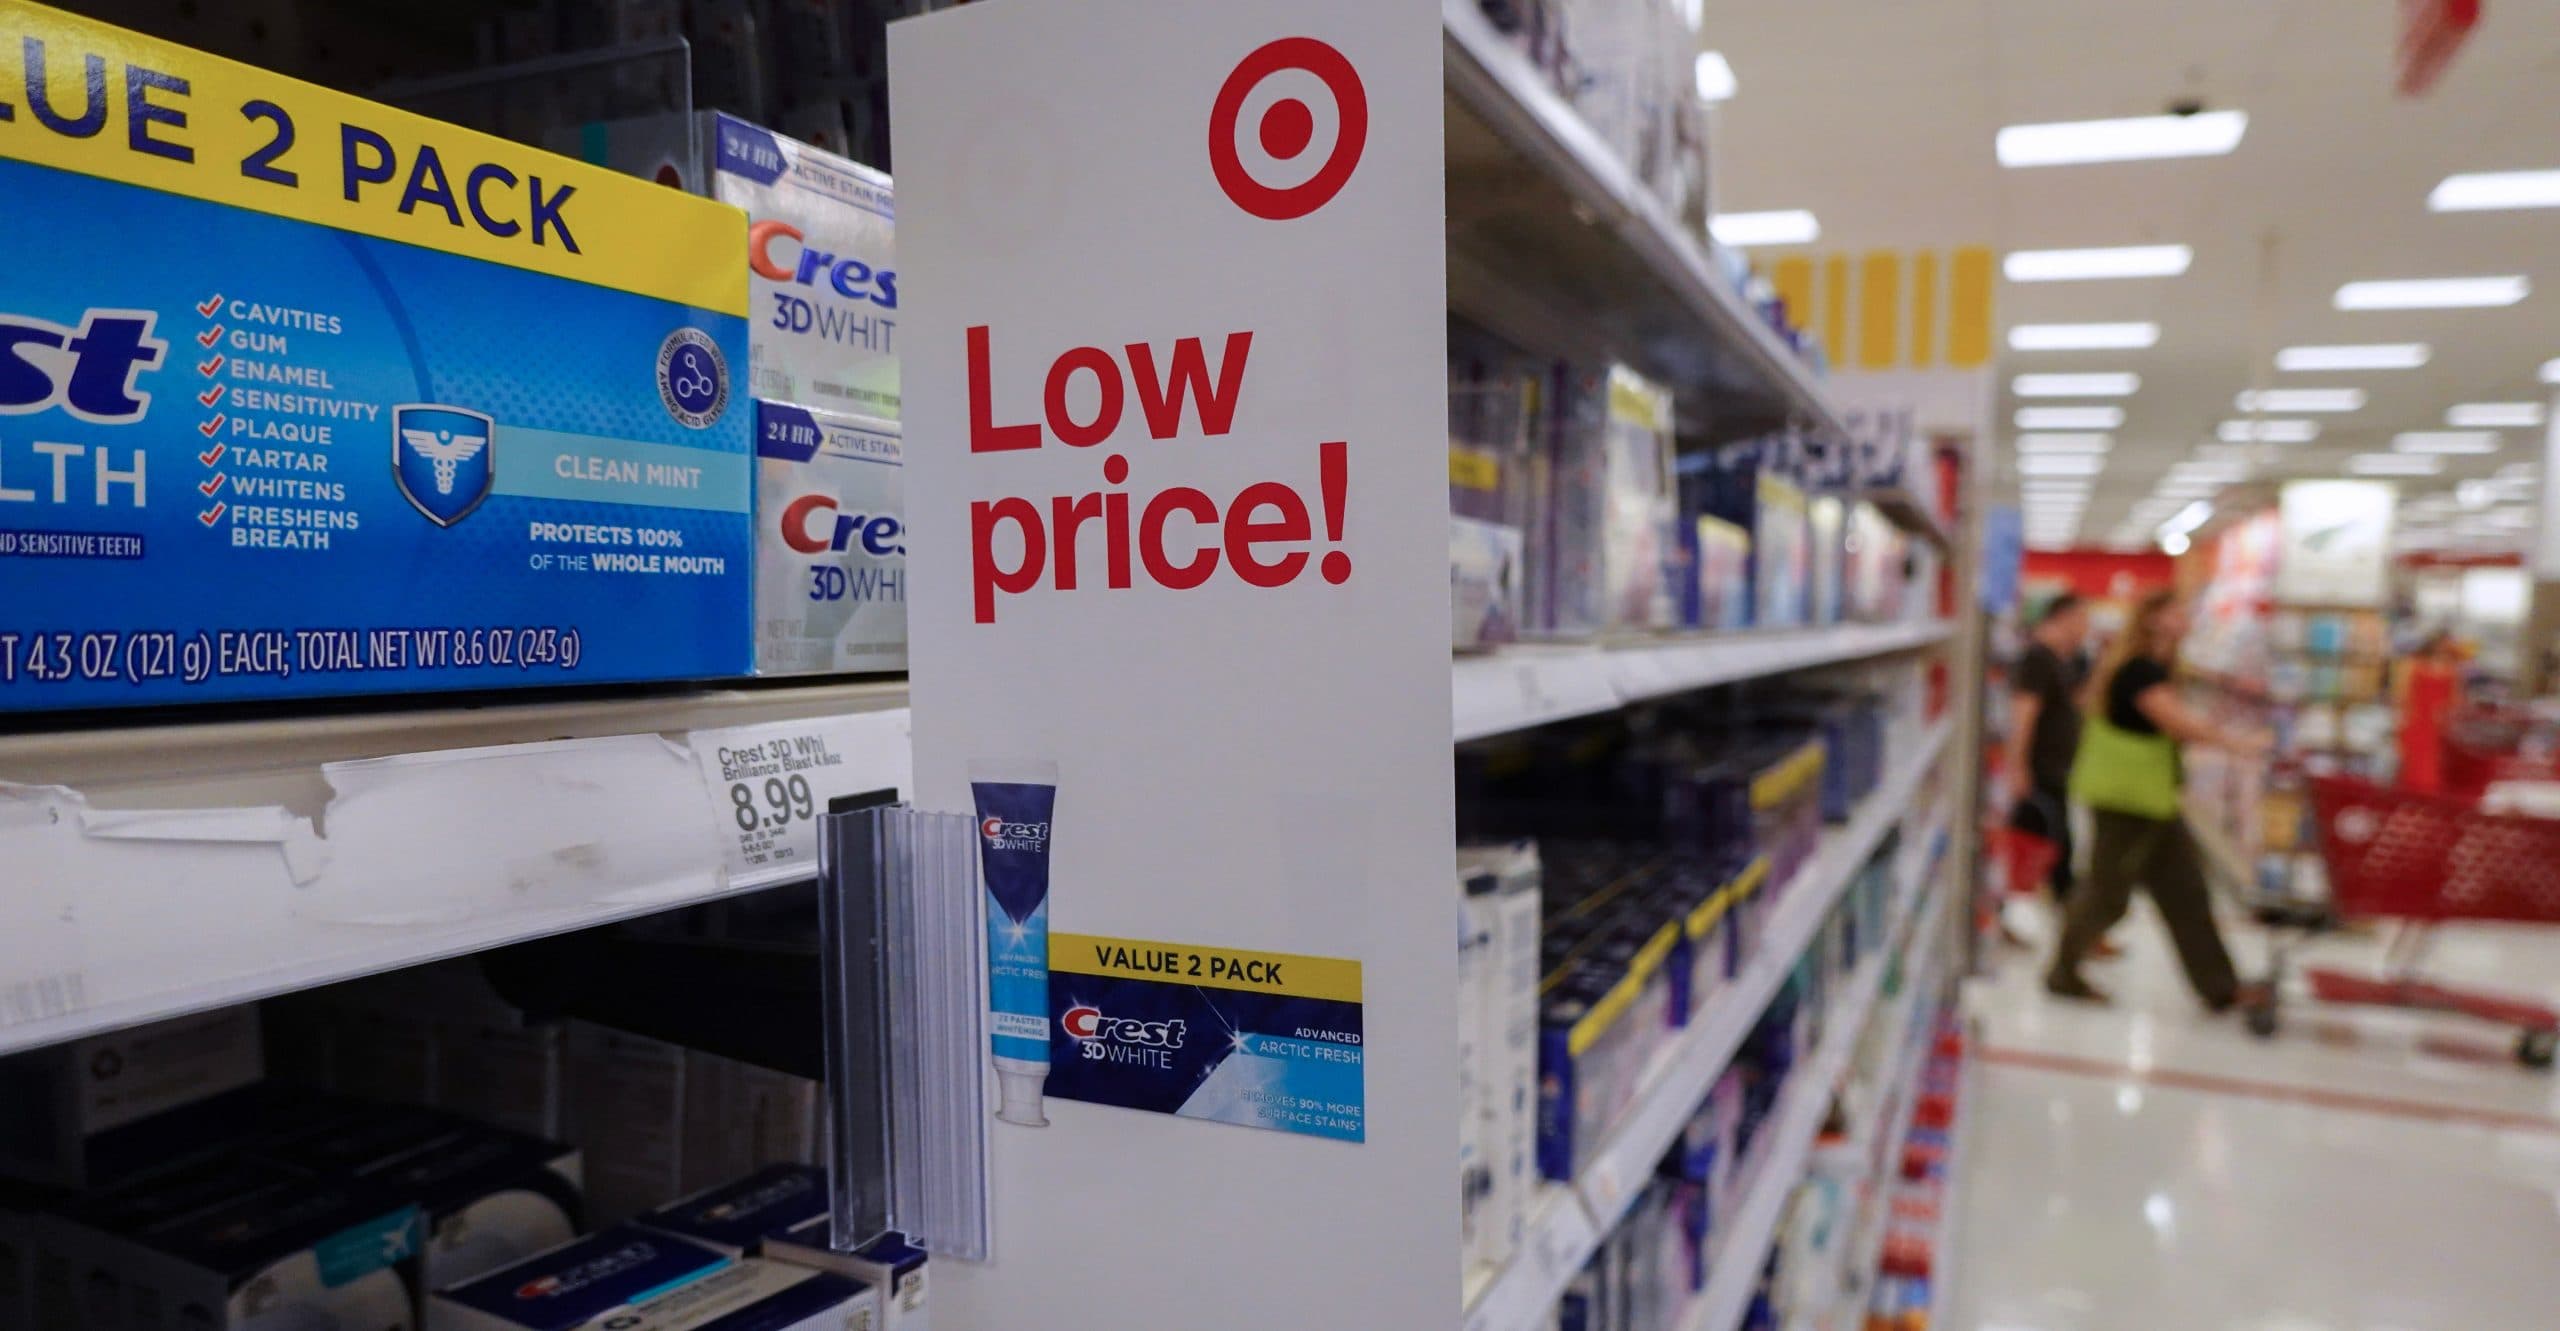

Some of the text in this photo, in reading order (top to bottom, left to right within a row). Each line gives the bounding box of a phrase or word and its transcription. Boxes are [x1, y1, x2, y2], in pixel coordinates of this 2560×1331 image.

[0, 35, 583, 256] UE 2 PACK
[754, 147, 779, 172] HR
[229, 300, 342, 335] CAVITIES
[230, 329, 288, 356] GUM
[231, 358, 334, 390] ENAMEL
[967, 325, 1254, 454] Low
[231, 388, 380, 422] SENSITIVITY
[232, 418, 332, 445] PLAQUE
[767, 422, 814, 447] 24 HR
[829, 432, 867, 452] ACTIVE
[232, 447, 328, 472] TARTAR
[555, 454, 702, 488] CLEAN MINT
[231, 476, 346, 501] WHITENS
[232, 505, 359, 530] FRESHENS
[20, 533, 95, 554] SENSITIVE
[99, 537, 141, 556] TEETH
[232, 528, 329, 549] BREATH
[530, 522, 683, 547] PROTECTS 100%
[971, 441, 1352, 625] price!
[529, 554, 725, 575] OF THE WHOLE MOUTH
[2, 629, 580, 683] T 4.3 OZ (121 g) EACH; TOTAL NET WT 8.6 OZ (243 g)
[718, 734, 826, 766] Crest 3D Whi
[723, 763, 780, 781] Brilliance
[782, 755, 813, 772] Blast
[731, 773, 815, 832] 8.99
[981, 817, 1048, 841] Crest
[1096, 945, 1283, 985] VALUE 2 PACK
[1062, 1006, 1187, 1049] Crest
[1294, 1027, 1361, 1044] ADVANCED
[1259, 1040, 1361, 1065] ARCTIC FRESH
[1258, 1106, 1311, 1125] SURFACE
[1299, 1099, 1324, 1111] 90%
[1327, 1102, 1361, 1117] MORE
